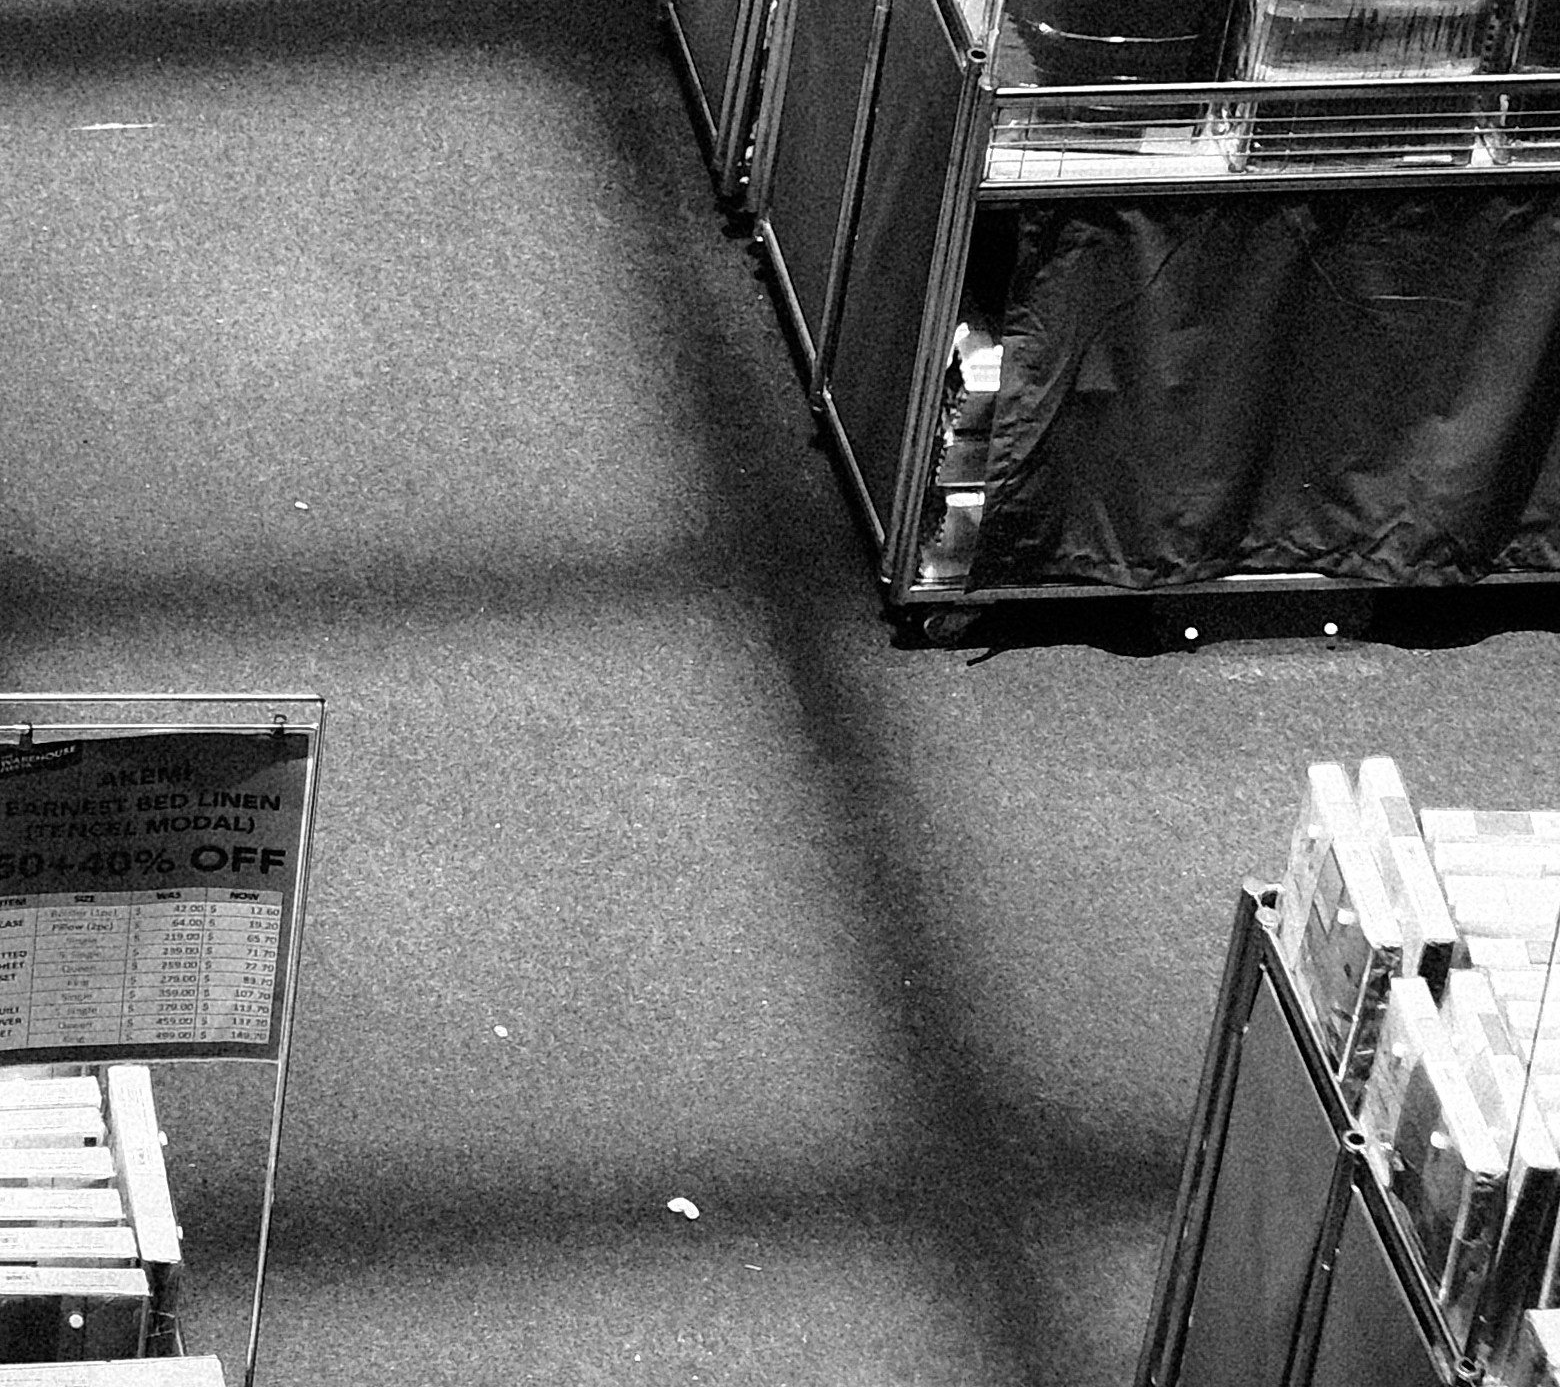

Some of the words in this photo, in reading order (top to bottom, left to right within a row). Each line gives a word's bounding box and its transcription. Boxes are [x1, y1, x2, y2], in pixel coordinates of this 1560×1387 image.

[96, 765, 194, 788] AKEMI
[4, 800, 129, 818] EARNEST
[136, 793, 188, 812] BED
[198, 792, 281, 812] LINEN
[145, 815, 256, 836] MODAL)
[191, 845, 286, 875] OFF
[74, 895, 95, 903] SIZE
[157, 891, 181, 901] WAS
[230, 892, 259, 901] NOW
